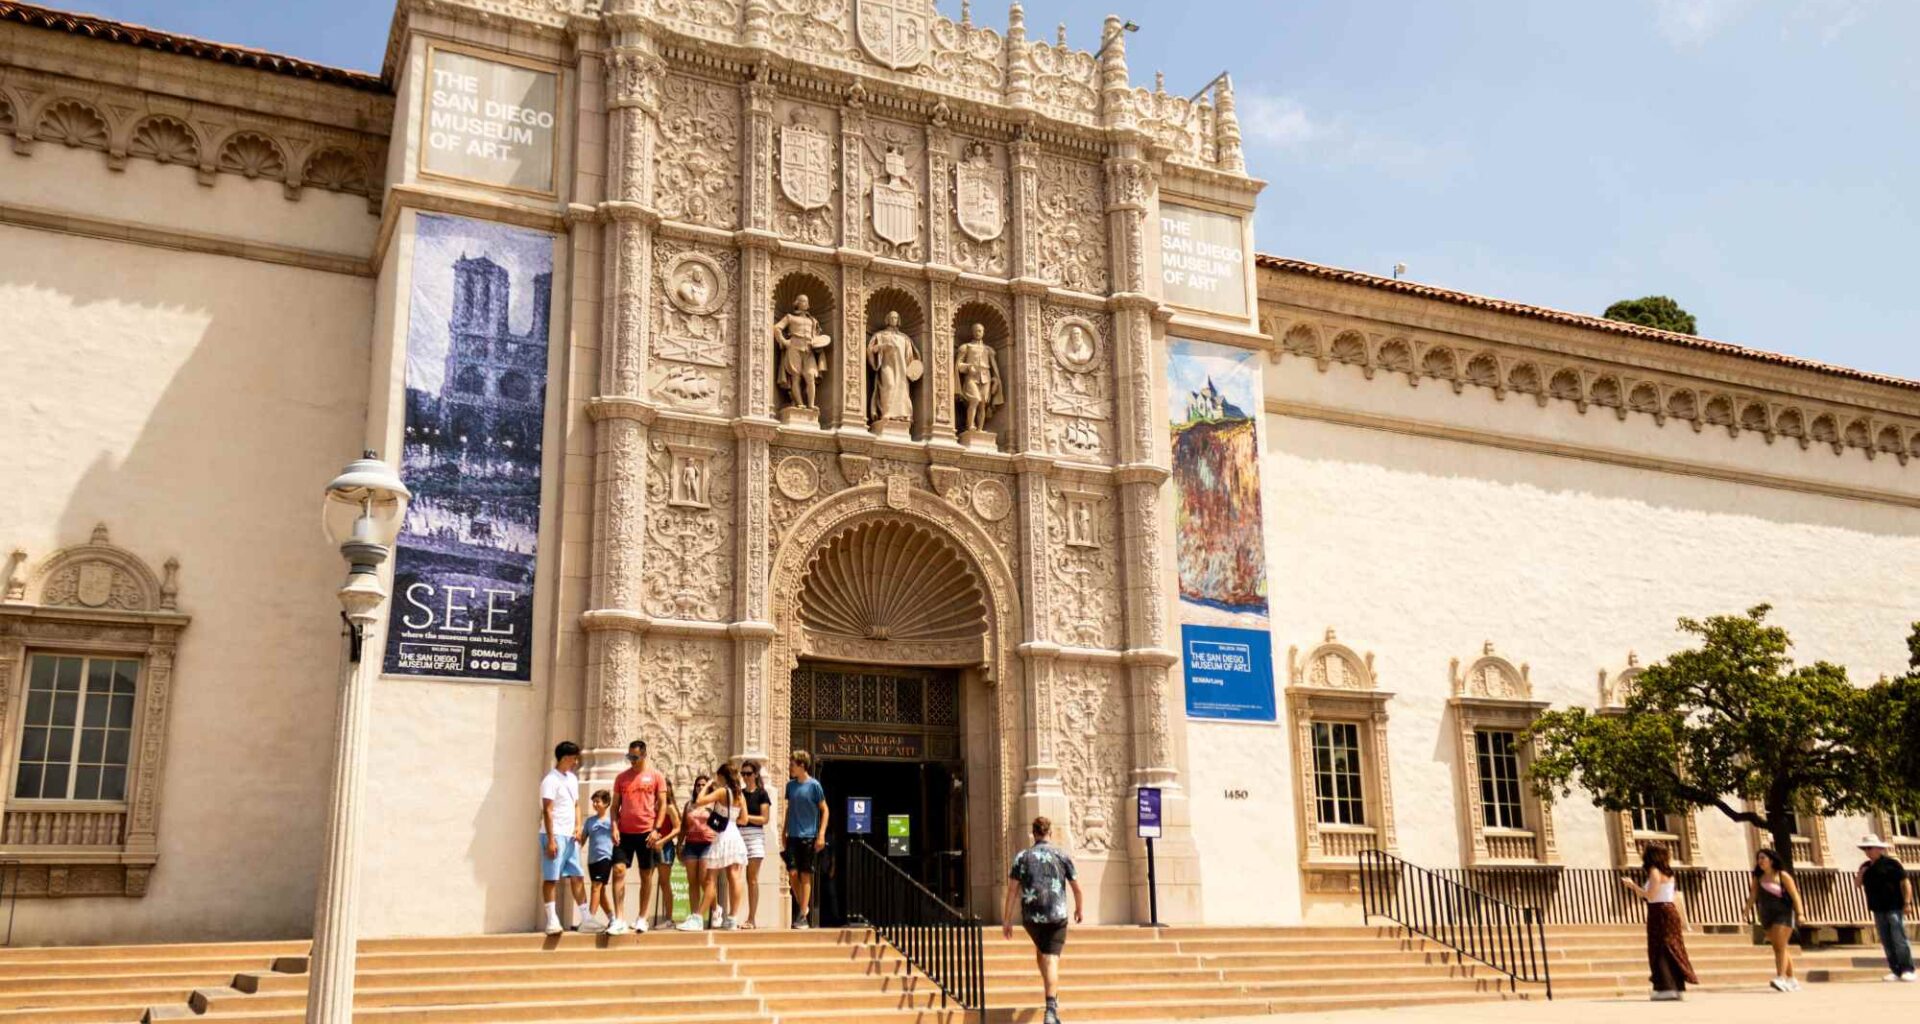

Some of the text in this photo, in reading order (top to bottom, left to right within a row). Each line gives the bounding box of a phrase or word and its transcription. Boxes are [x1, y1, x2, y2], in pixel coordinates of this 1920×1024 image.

[433, 69, 479, 94] THE
[432, 91, 554, 128] SAN DIEGO
[430, 111, 533, 145] MUSEUM
[430, 132, 512, 161] OF ART
[1161, 218, 1191, 236] THE
[1162, 235, 1242, 262] SAN DIEGO
[1162, 252, 1232, 278] MUSEUM
[1163, 270, 1218, 292] OF ART
[402, 583, 516, 634] SEE
[401, 631, 424, 639] where
[424, 631, 437, 639] the
[434, 655, 457, 663] DIEGO
[471, 649, 518, 660] SDMArt.org
[1192, 653, 1244, 663] THE SAN DIEGO
[398, 660, 460, 670] MUSEUM OF ART
[1191, 661, 1247, 672] MUSEUM OF ART
[838, 734, 899, 745] SAN DIEGO
[822, 743, 915, 756] MUSEUM OF ART
[1224, 789, 1249, 800] 1450
